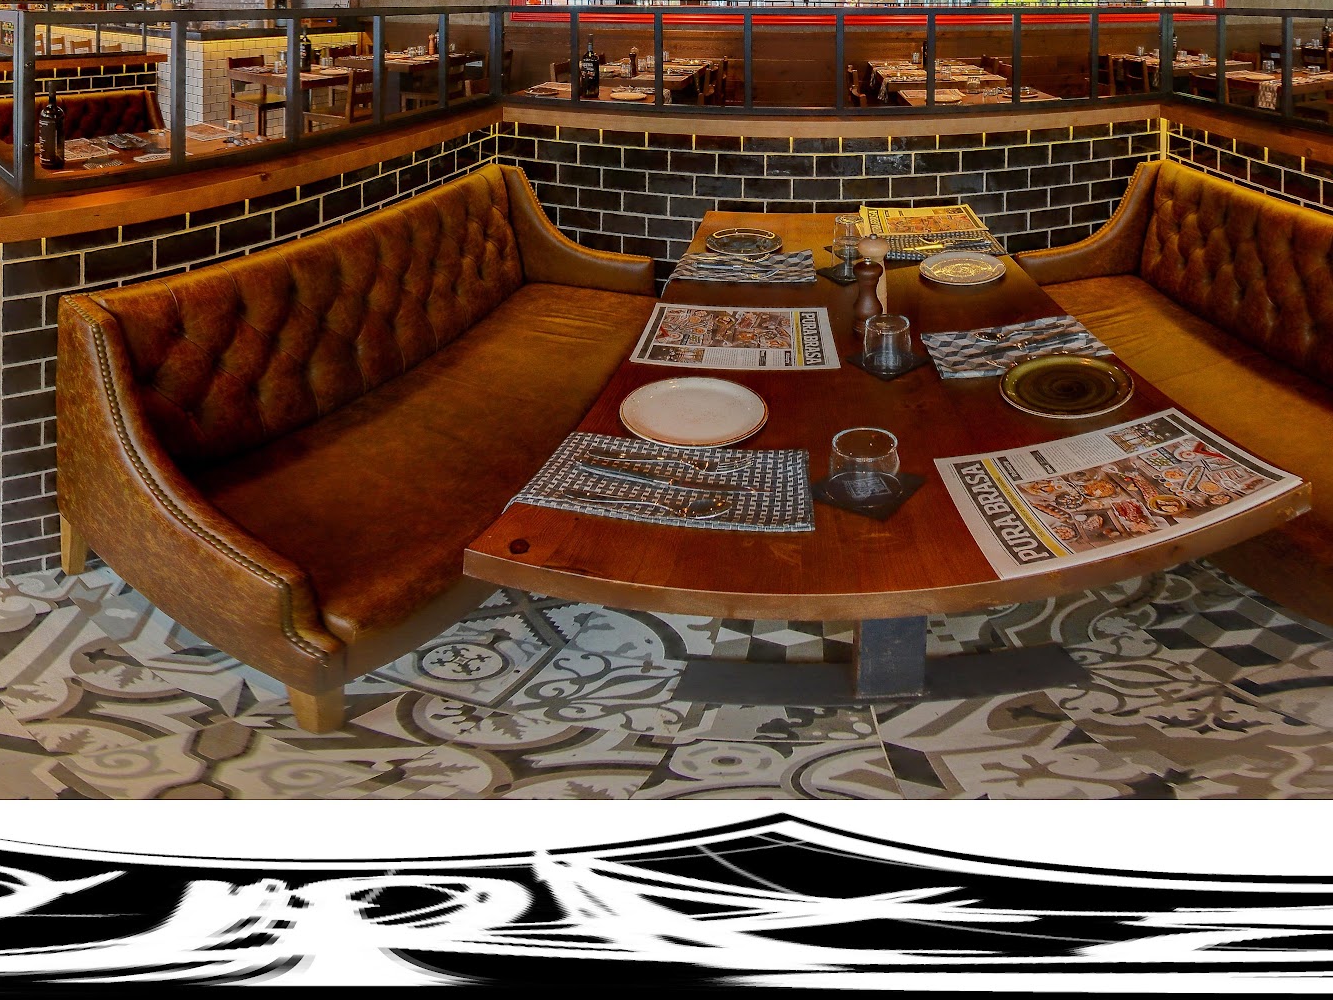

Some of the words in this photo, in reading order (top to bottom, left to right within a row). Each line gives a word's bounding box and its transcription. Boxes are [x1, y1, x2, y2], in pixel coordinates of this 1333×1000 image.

[801, 312, 817, 335] PURA
[803, 335, 822, 365] BRASA
[962, 463, 1012, 516] BRASA
[993, 514, 1050, 562] PURA
